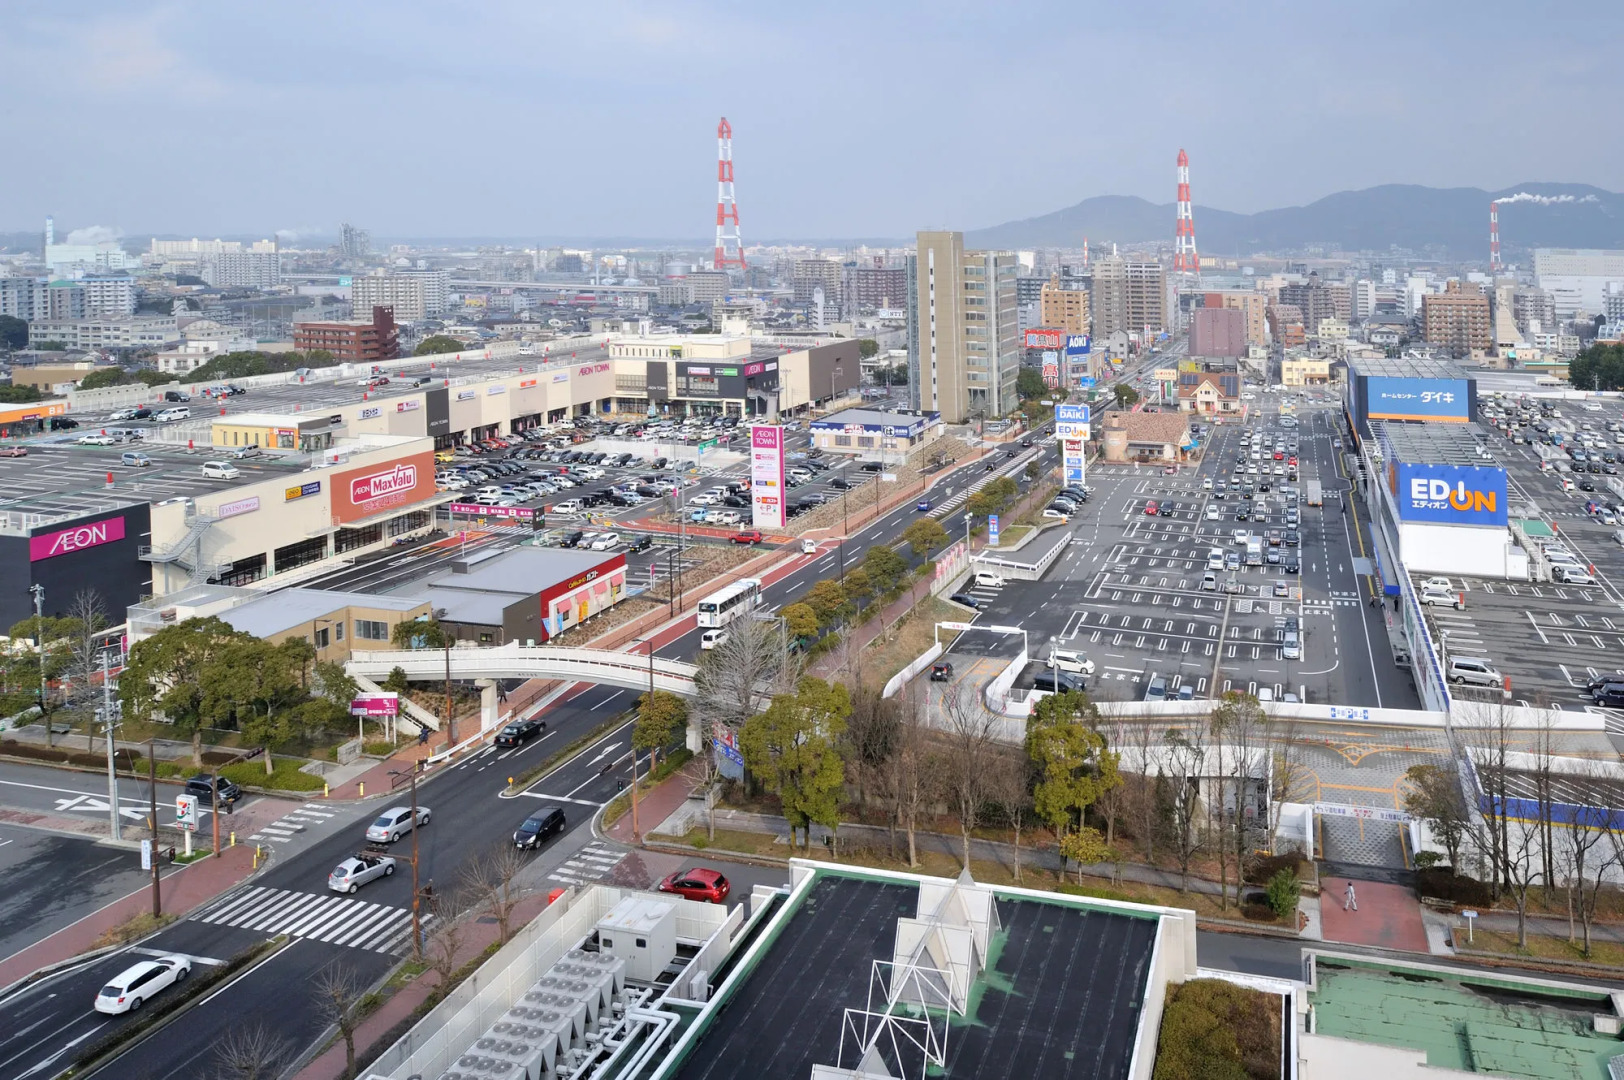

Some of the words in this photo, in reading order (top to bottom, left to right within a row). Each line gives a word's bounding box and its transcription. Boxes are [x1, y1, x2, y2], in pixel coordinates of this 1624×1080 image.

[1069, 335, 1087, 348] AOKI
[594, 363, 610, 374] TOWN
[1420, 391, 1455, 404] ダイキ
[1058, 425, 1087, 438] EDION
[755, 437, 775, 445] TOWN
[373, 465, 412, 494] MaxValu
[1067, 469, 1075, 478] P
[1411, 478, 1496, 512] EDION
[1412, 500, 1449, 510] エディオン
[1101, 671, 1140, 683] 止まれ
